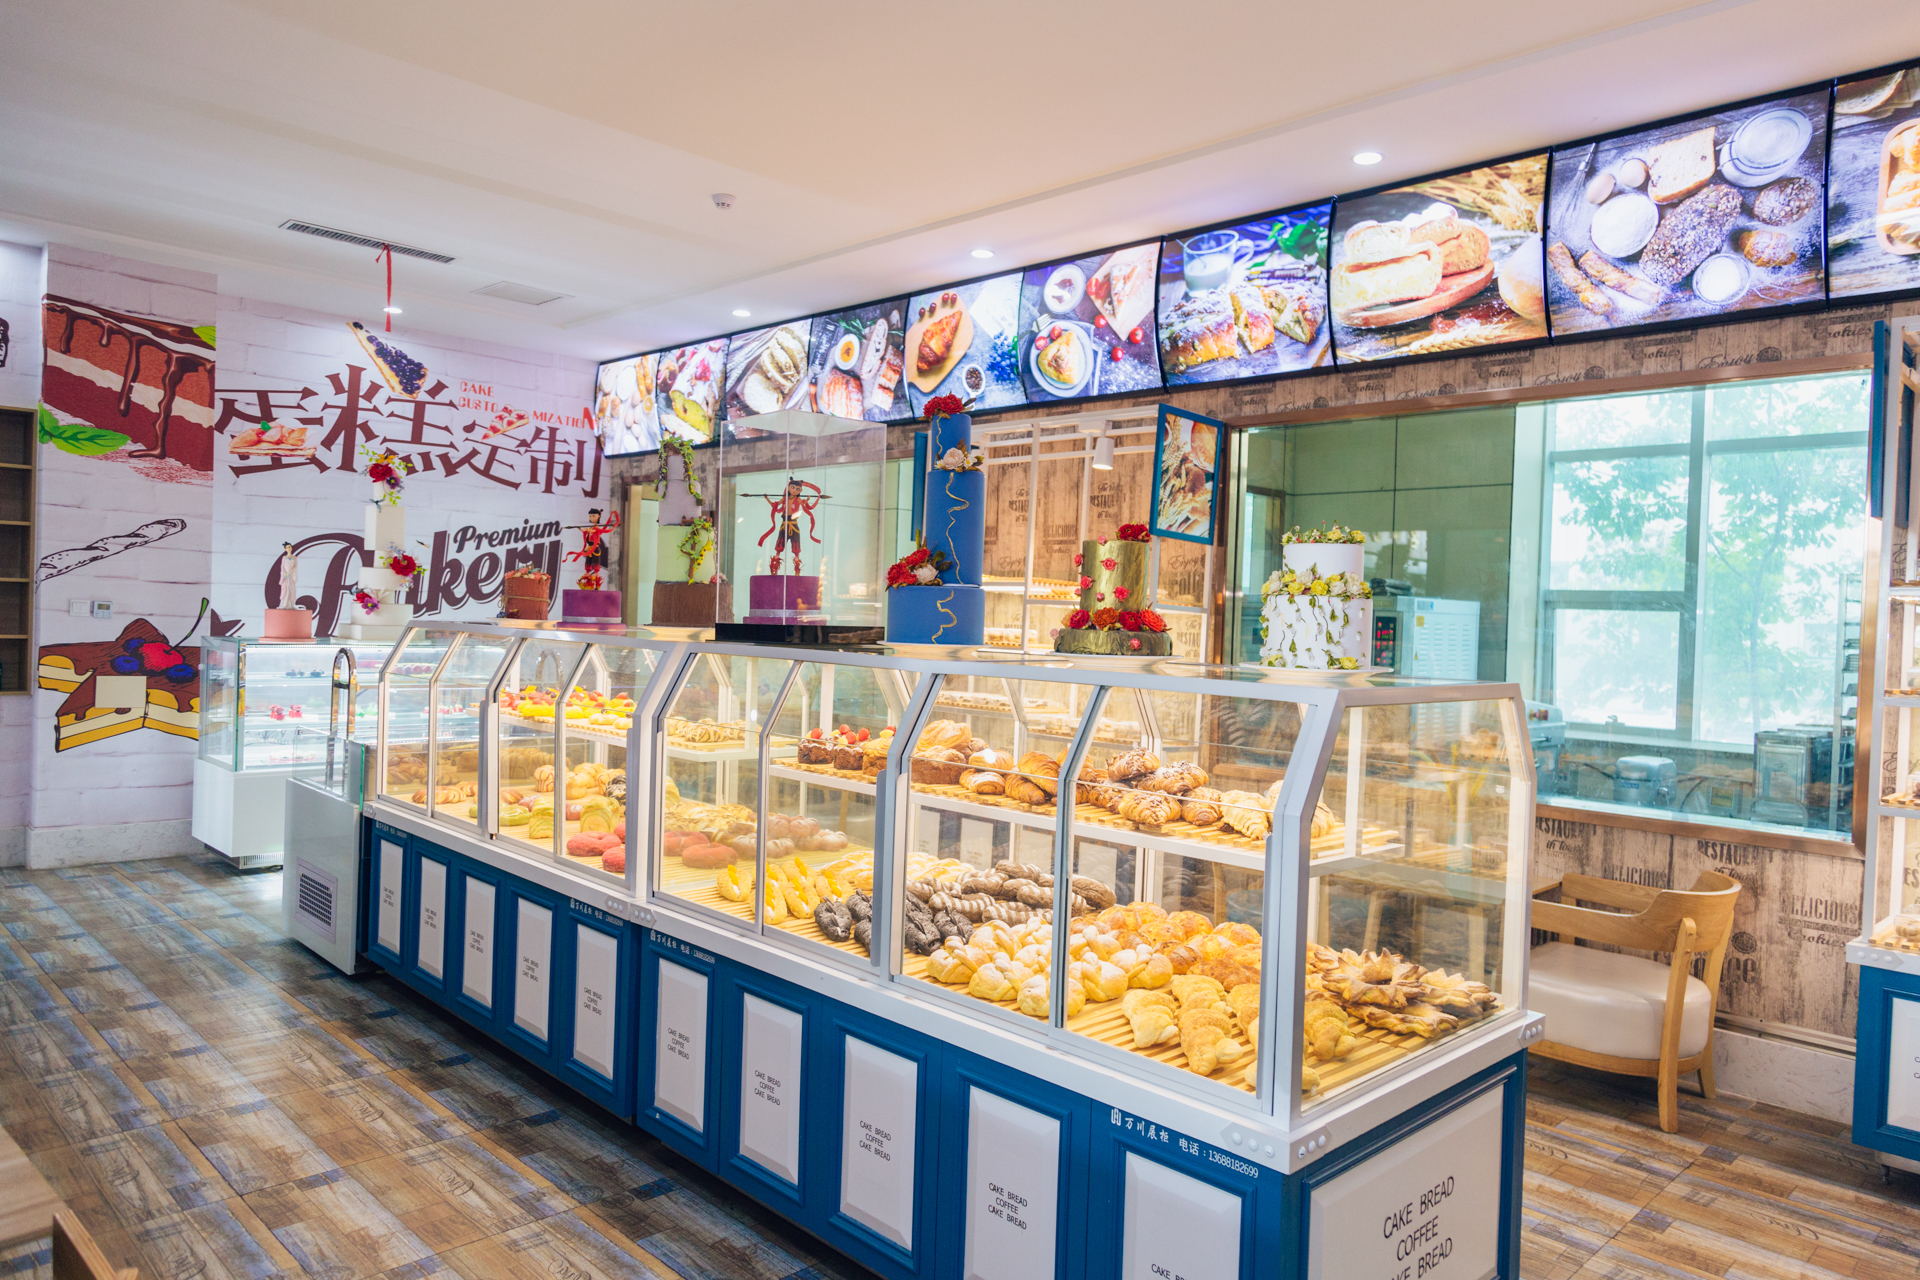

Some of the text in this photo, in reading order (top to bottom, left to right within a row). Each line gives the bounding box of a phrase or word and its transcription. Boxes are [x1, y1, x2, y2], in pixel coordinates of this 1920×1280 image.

[460, 381, 494, 397] CAKE
[215, 363, 602, 499] 蛋糕定制
[454, 519, 562, 553] Premium
[667, 1027, 690, 1043] CAKE BREAD
[672, 1038, 684, 1049] COFFEE
[667, 1044, 690, 1060] CAKE BREAD
[755, 1070, 781, 1087] CAKE BREAD
[760, 1081, 775, 1094] COFFEE
[754, 1088, 780, 1106] CAKE BREAD
[860, 1120, 891, 1141] CAKE BREAD
[865, 1133, 883, 1148] COFFEE
[1125, 1117, 1169, 1143] 万川展柜
[859, 1140, 891, 1162] CAKE BREAD
[988, 1182, 1027, 1207] CAKE BREAD
[995, 1197, 1018, 1215] COFFEE
[1384, 1176, 1455, 1239] CAKE BREAD
[988, 1204, 1027, 1230] CAKE BREAD
[1397, 1215, 1439, 1261] COFFEE
[1418, 1237, 1453, 1279] BREAD
